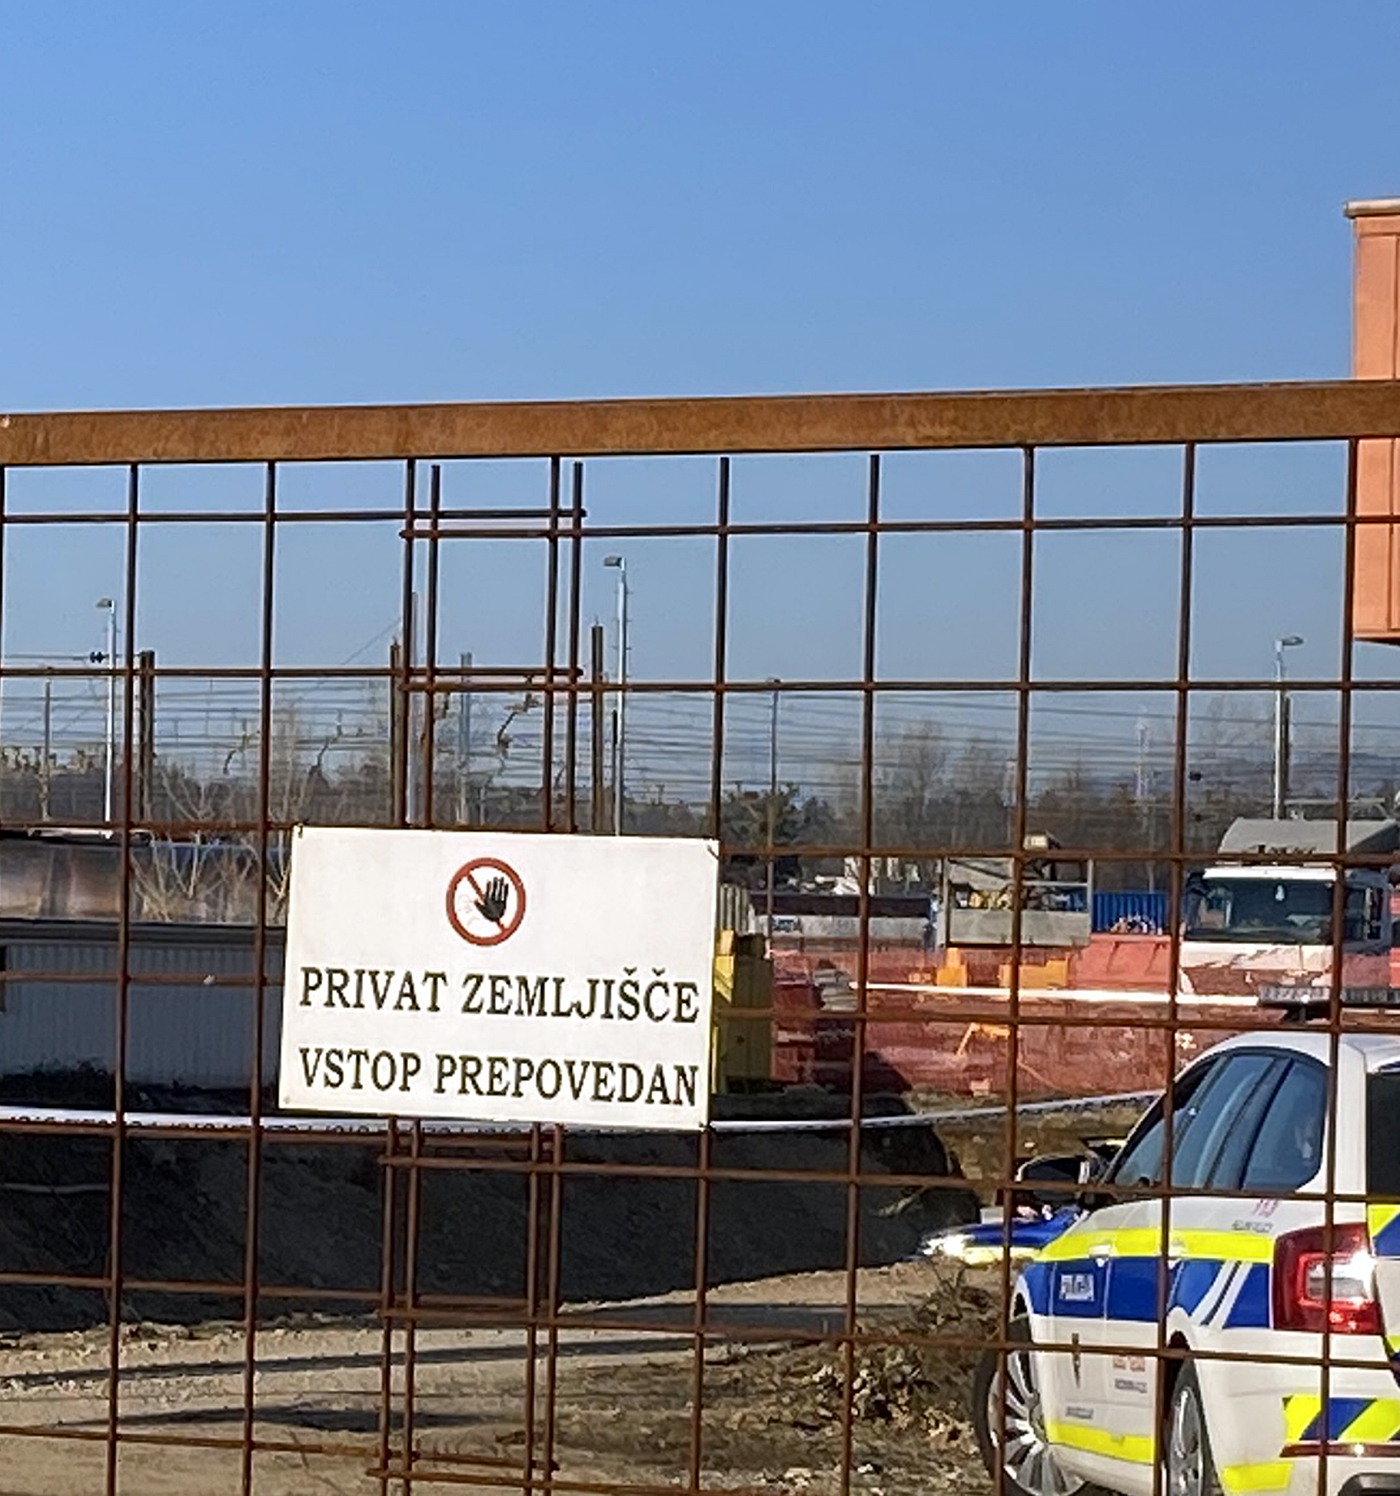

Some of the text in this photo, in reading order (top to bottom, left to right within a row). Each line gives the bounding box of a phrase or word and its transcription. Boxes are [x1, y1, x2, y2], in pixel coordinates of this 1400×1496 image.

[300, 966, 699, 1022] PRIVAT ZEMLJIŠČE
[300, 1047, 698, 1106] VSTOP PREPOVEDAN
